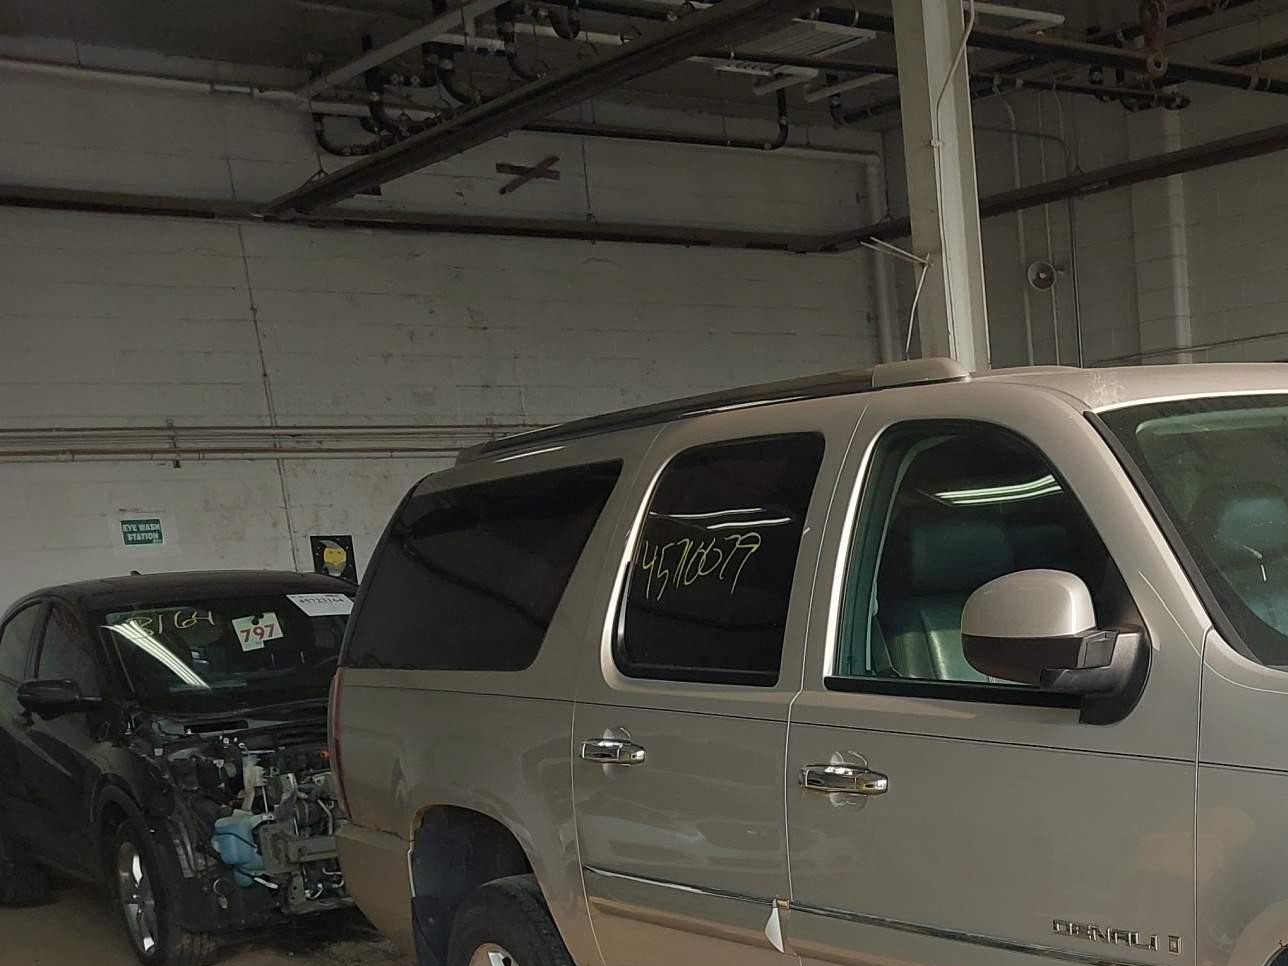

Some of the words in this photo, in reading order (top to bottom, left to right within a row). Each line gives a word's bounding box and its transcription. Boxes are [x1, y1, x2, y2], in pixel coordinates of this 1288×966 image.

[122, 524, 137, 532] EYE
[139, 523, 160, 531] WASH
[127, 532, 159, 541] STATION
[239, 623, 275, 643] 797
[1053, 919, 1159, 951] DENALI
